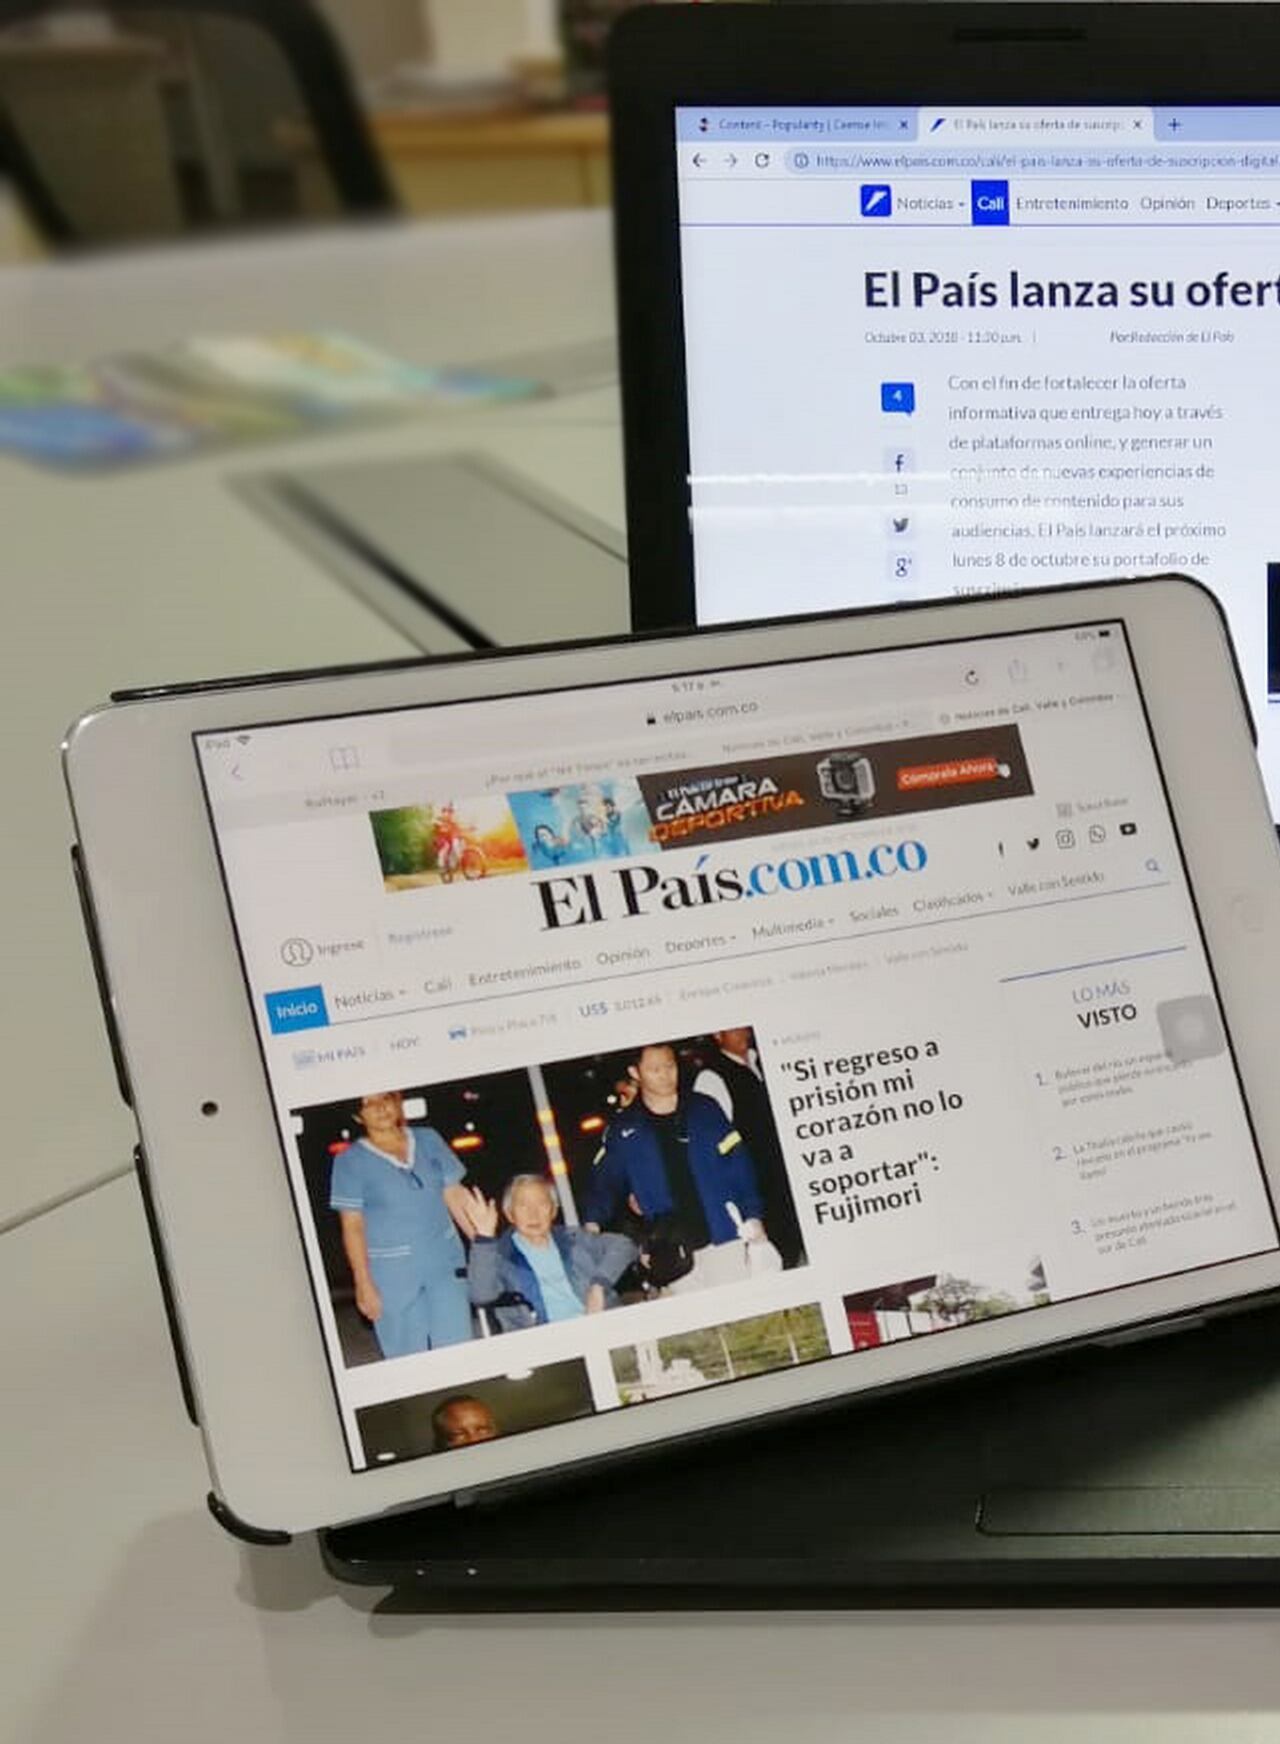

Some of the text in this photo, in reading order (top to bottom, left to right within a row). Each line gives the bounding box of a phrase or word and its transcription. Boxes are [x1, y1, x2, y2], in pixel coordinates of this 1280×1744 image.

[896, 196, 954, 210] Noticias
[976, 195, 1005, 211] Cali
[1016, 195, 1129, 211] Entretenimiento
[1140, 194, 1196, 212] Opinión
[1206, 195, 1271, 213] Deportes
[863, 270, 900, 309] El
[912, 270, 999, 309] País
[1010, 270, 1119, 309] lanza
[1128, 280, 1175, 309] su
[948, 374, 1187, 391] Con el fin de fortalecer la oferta
[948, 406, 1037, 421] informativa
[1040, 409, 1068, 423] que
[1071, 408, 1131, 424] entrega
[1133, 407, 1161, 424] hoy
[1177, 405, 1224, 421] través
[949, 436, 968, 450] de
[972, 436, 1063, 452] plataformas
[1064, 436, 1117, 452] online,
[1130, 440, 1188, 454] generar
[1191, 440, 1213, 450] un
[1044, 466, 1096, 481] nuevas
[1099, 464, 1193, 483] experiencias
[1195, 464, 1215, 480] de
[950, 494, 1185, 511] consumo de contenido para sus
[1037, 523, 1227, 541] El País lanzará el próximo
[952, 552, 1210, 570] lunes 8 de octubre su portafolio de
[649, 789, 806, 843] DEPORTIVA
[530, 837, 929, 933] El País.com.co
[275, 870, 1106, 1020] Inicio Noticias Cali Entretenimiento Opinión Deportes Multimedia Sociales Clasificados Valle con Sentido
[1071, 979, 1132, 1005] LO MÁS
[578, 1002, 609, 1019] US$
[1076, 1002, 1138, 1031] VISTO
[779, 1040, 940, 1083] "Si regreso a
[788, 1068, 915, 1118] prisión mi
[795, 1089, 965, 1141] corazón no lo
[801, 1143, 855, 1169] va a
[807, 1151, 940, 1198] soportar":
[813, 1181, 924, 1226] Fujimori
